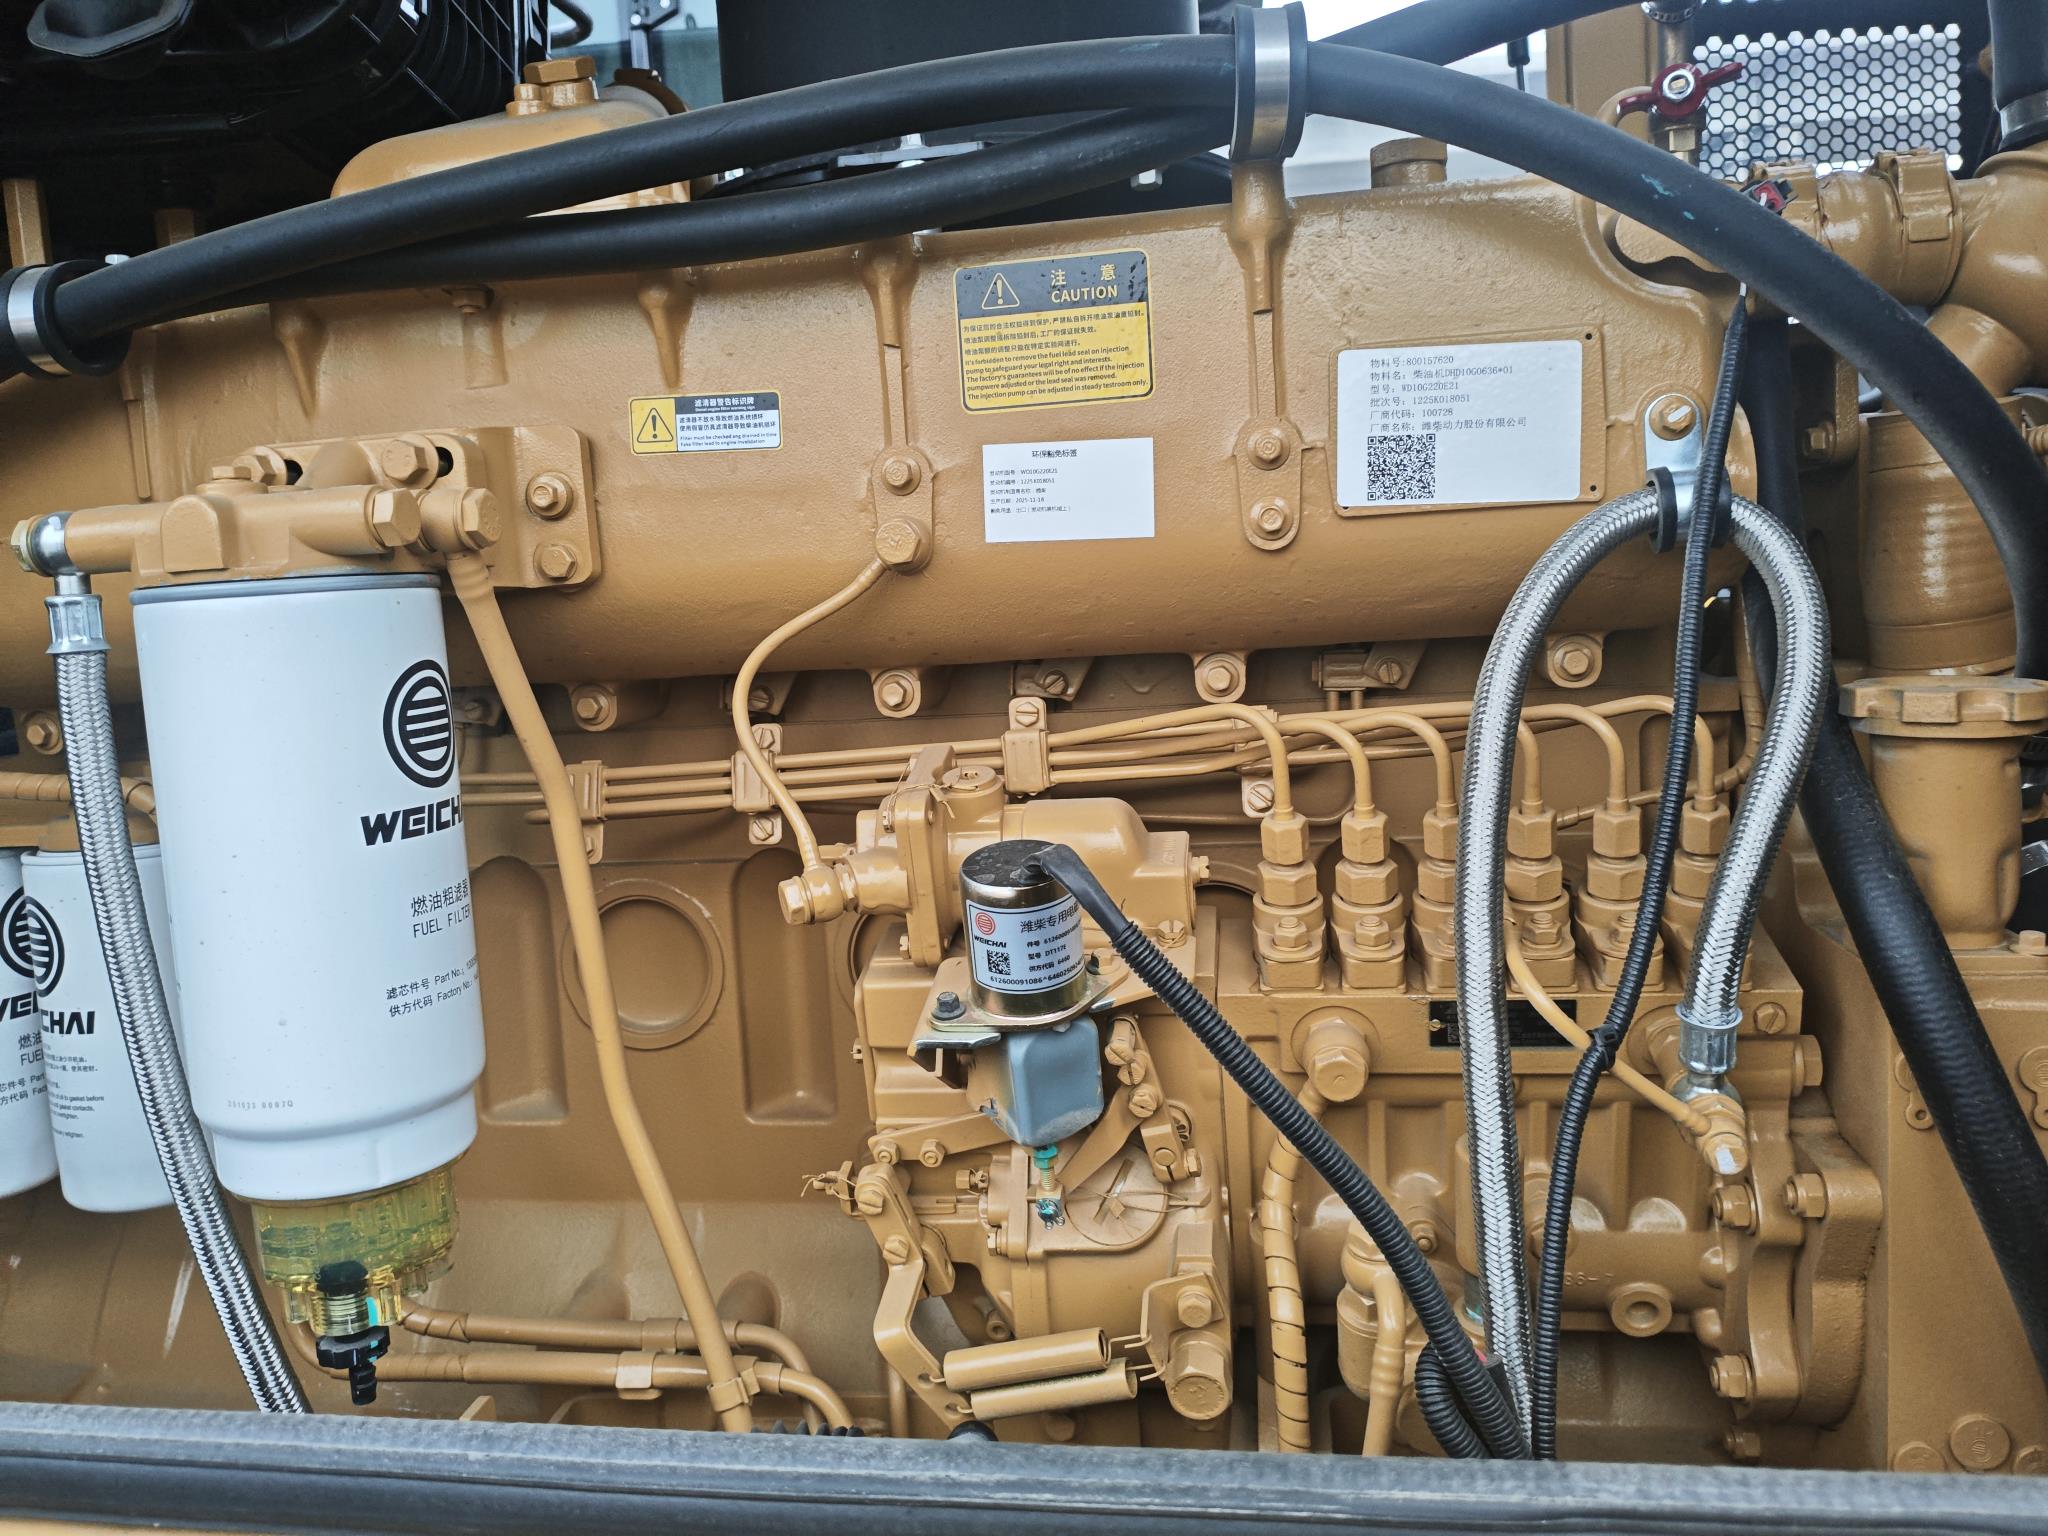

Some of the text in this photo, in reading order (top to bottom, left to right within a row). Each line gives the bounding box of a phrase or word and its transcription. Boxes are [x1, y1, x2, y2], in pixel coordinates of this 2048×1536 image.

[1051, 285, 1118, 303] CAUTION
[413, 918, 443, 938] FUEL
[973, 933, 1007, 949] WEICHAI
[386, 978, 430, 1000] 滤芯件号
[434, 972, 451, 985] Part
[389, 995, 433, 1017] 供方代码
[437, 984, 462, 1003] Factory
